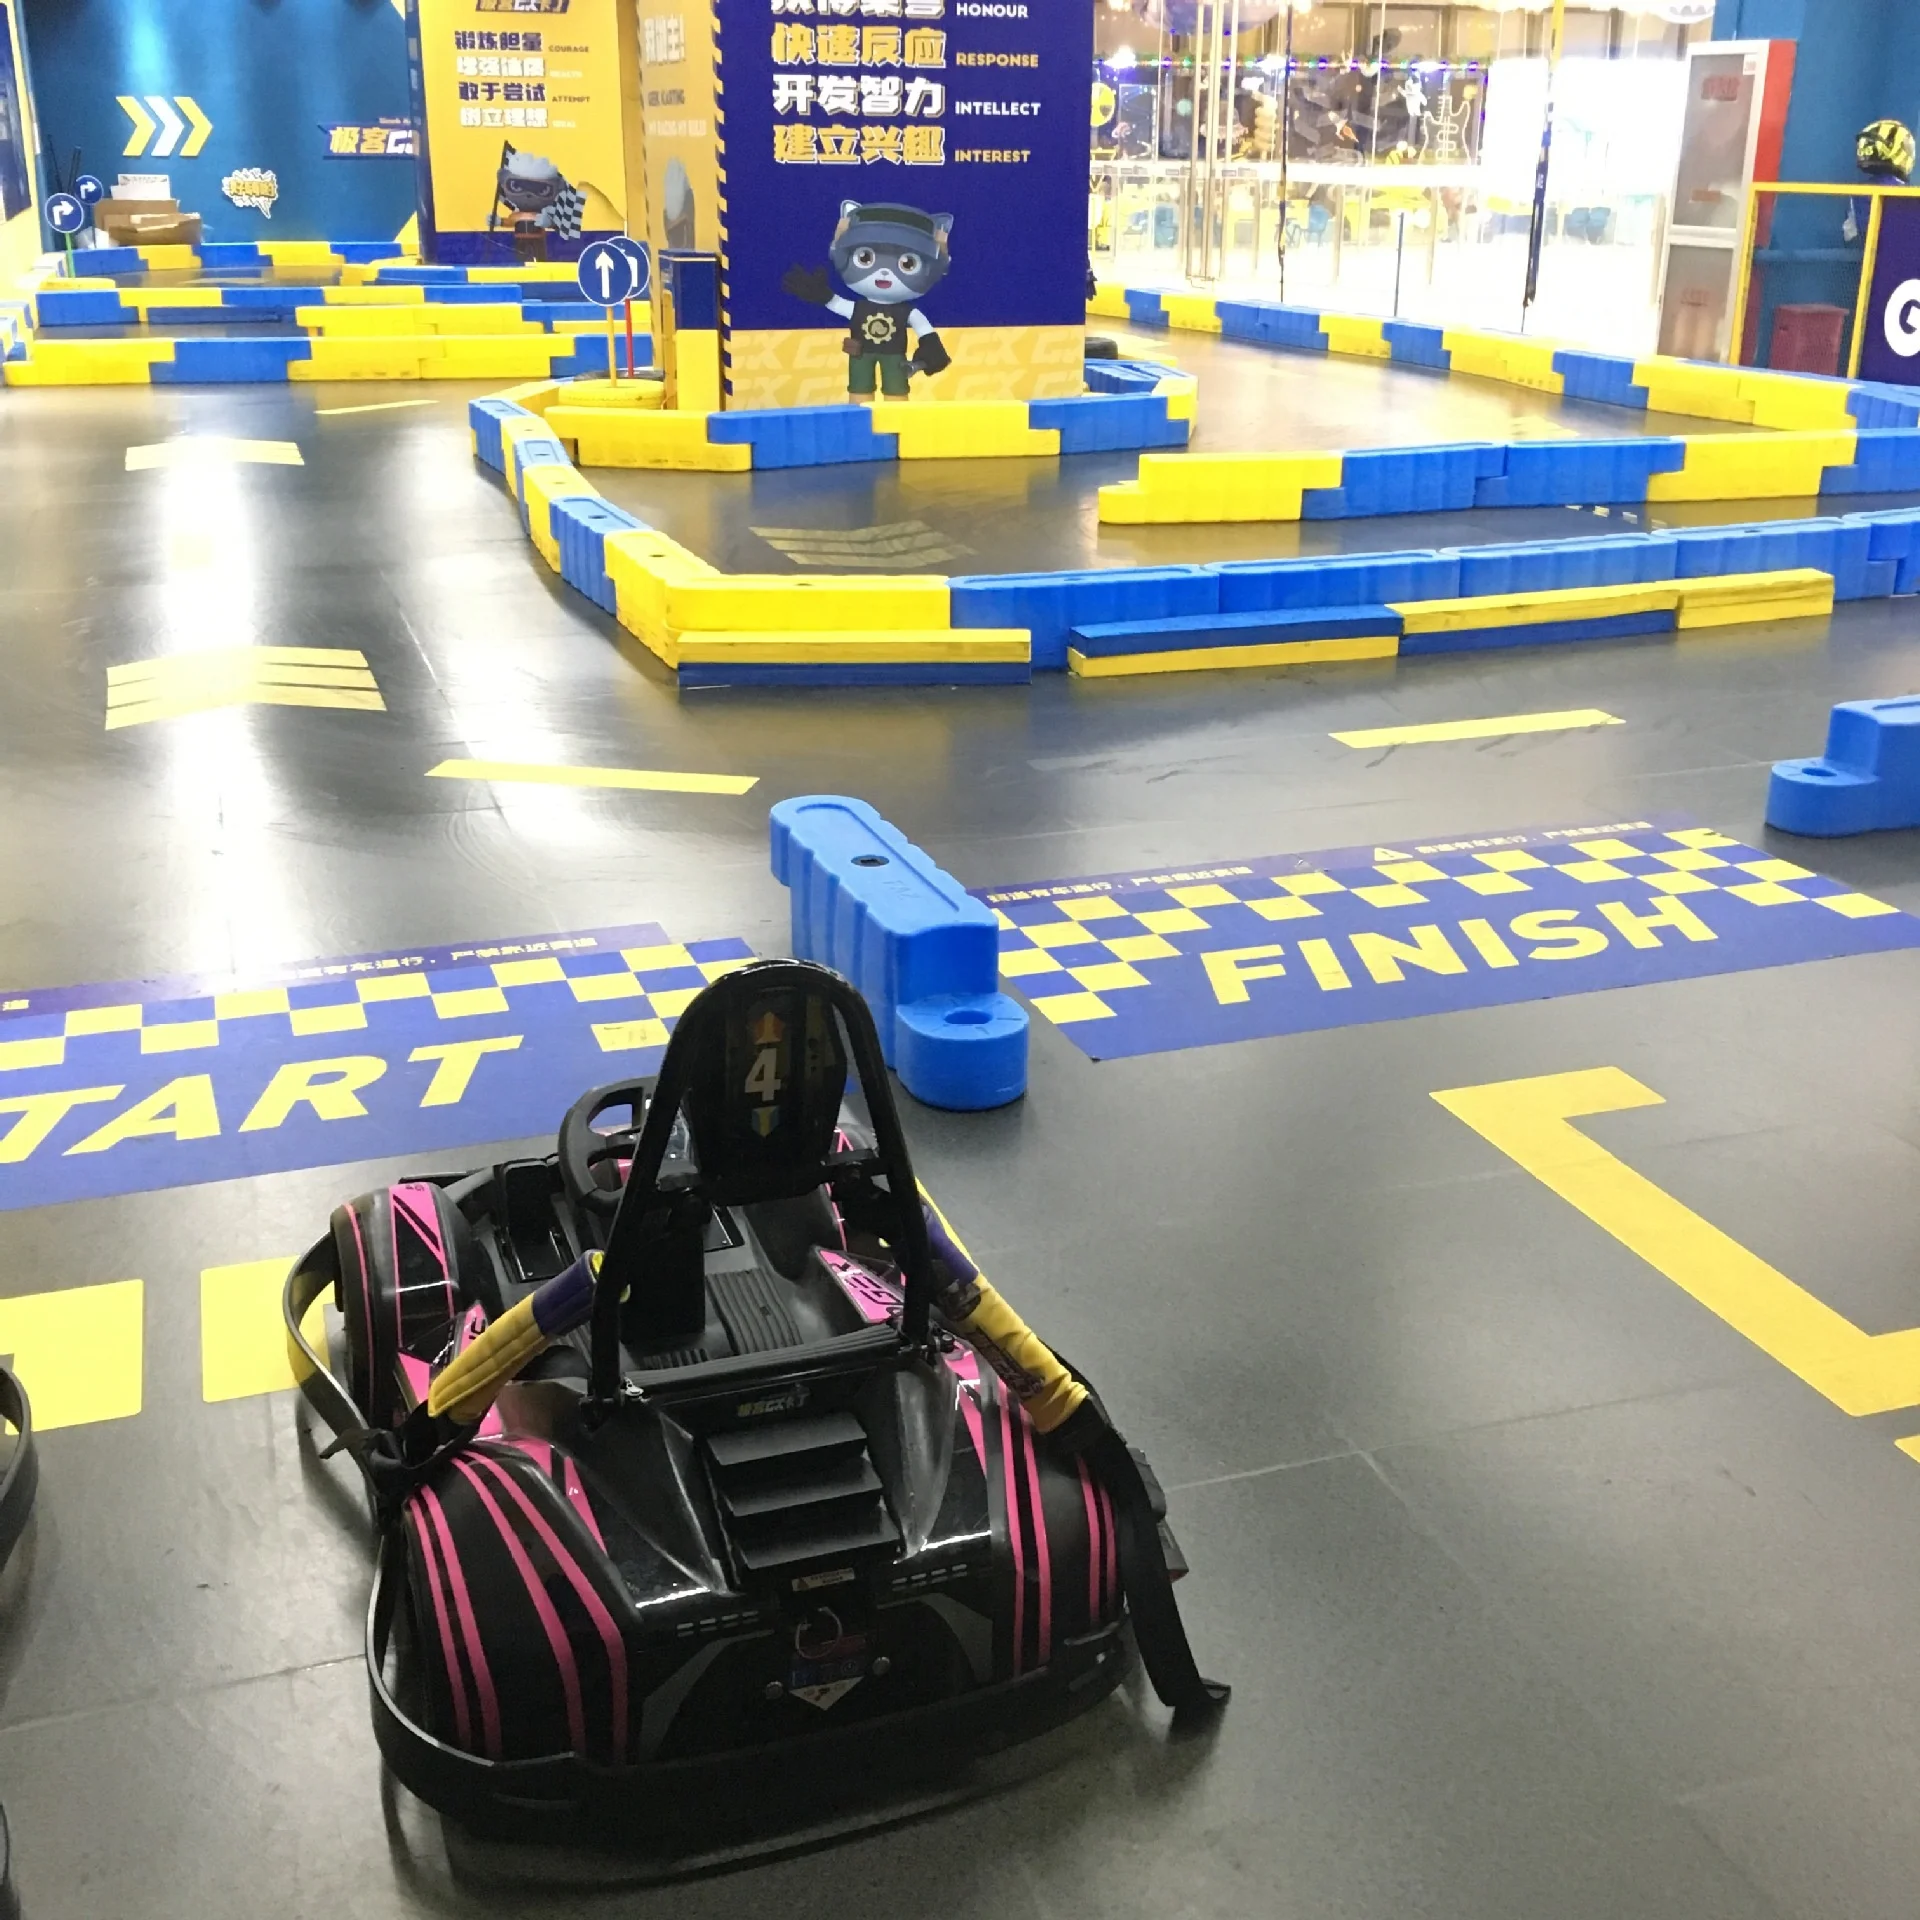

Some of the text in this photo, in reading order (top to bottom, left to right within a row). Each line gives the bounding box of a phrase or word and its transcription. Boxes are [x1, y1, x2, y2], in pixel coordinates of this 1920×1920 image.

[956, 3, 1028, 18] HONOUR
[771, 22, 947, 68] 快速反应
[956, 53, 1039, 68] RESPONSE
[458, 81, 546, 102] 敢于尝试
[773, 74, 946, 117] 开发智力
[954, 101, 1041, 116] INTELLECT
[773, 123, 946, 165] 建立兴趣
[954, 149, 1031, 163] INTEREST
[1200, 895, 1719, 1005] FINISH
[745, 1048, 781, 1101] 4
